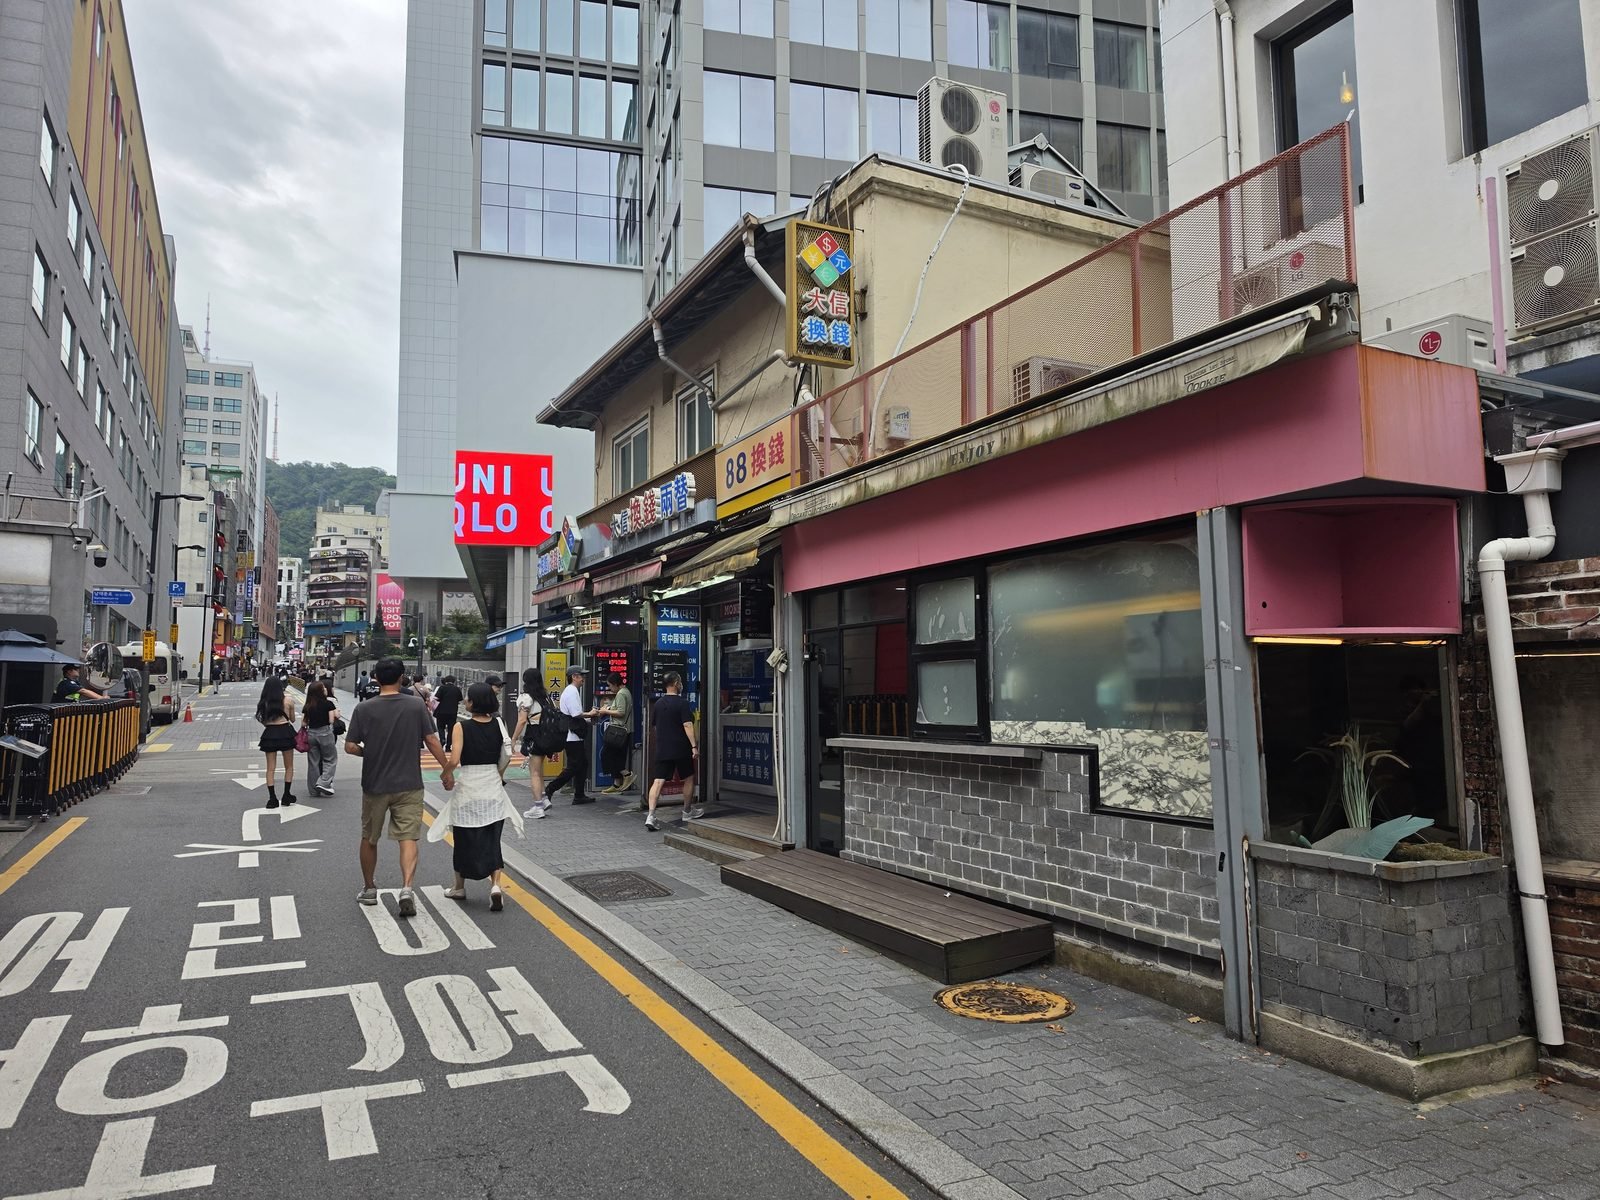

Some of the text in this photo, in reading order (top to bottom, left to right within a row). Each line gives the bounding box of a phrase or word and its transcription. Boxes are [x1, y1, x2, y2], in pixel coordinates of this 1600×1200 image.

[991, 115, 1000, 123] LG
[806, 288, 849, 316] 大信
[807, 317, 850, 346] 換錢
[1187, 373, 1227, 393] COOKIE
[727, 730, 770, 744] NO COMMISSION
